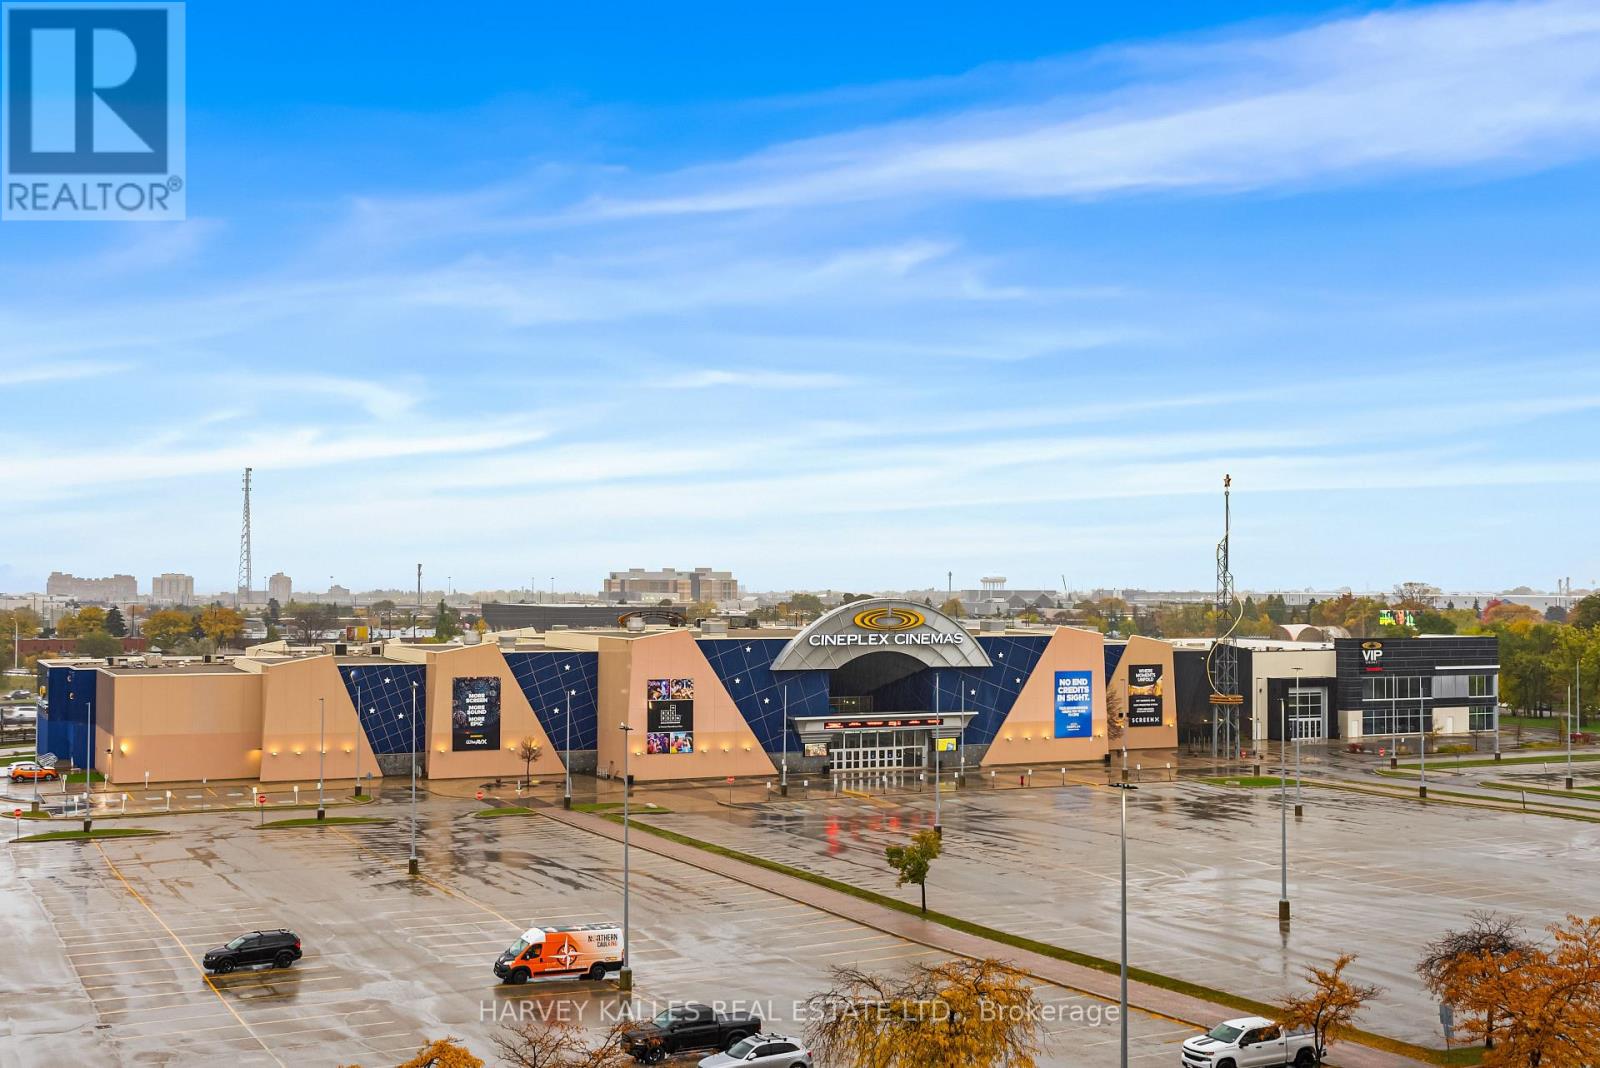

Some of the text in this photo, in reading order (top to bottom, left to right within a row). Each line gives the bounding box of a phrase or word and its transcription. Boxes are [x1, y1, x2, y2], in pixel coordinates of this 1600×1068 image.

[808, 632, 964, 646] CINEPLEX CINEMAS
[1362, 650, 1383, 661] VIP
[1059, 678, 1088, 686] NO END
[1057, 686, 1090, 694] CREDITS
[1057, 694, 1066, 702] IN
